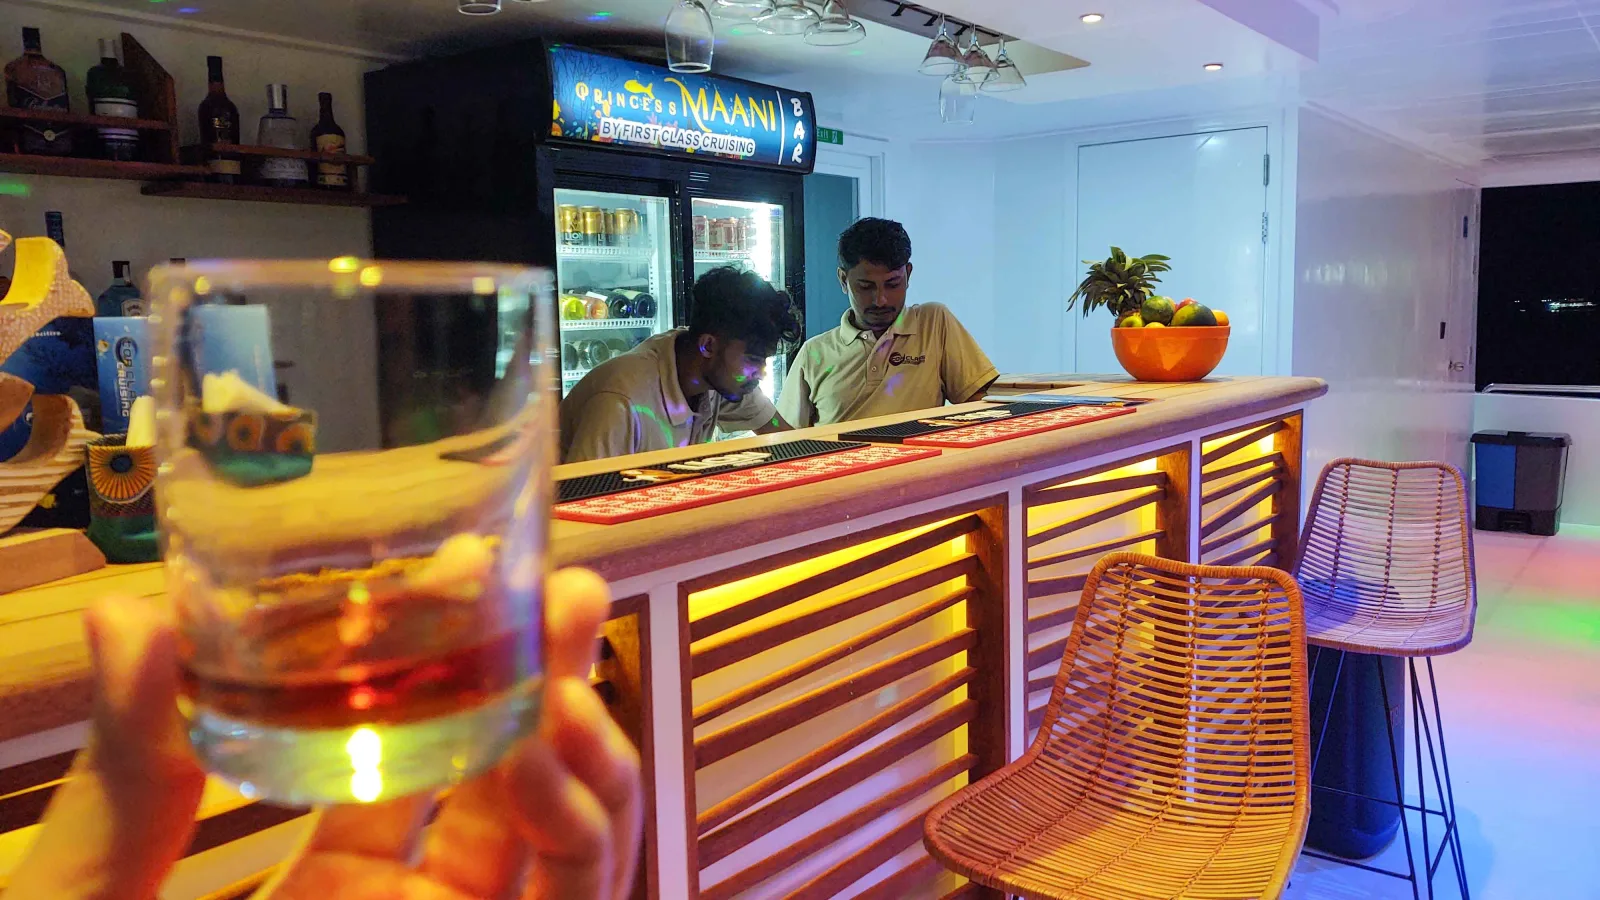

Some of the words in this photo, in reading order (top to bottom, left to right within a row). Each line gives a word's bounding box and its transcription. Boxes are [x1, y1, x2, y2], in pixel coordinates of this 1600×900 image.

[664, 77, 776, 133] MAANI
[790, 98, 806, 164] BAR
[602, 121, 622, 136] BY
[622, 124, 660, 142] FIRST
[661, 130, 700, 147] CLASS
[702, 136, 755, 155] CRUISING
